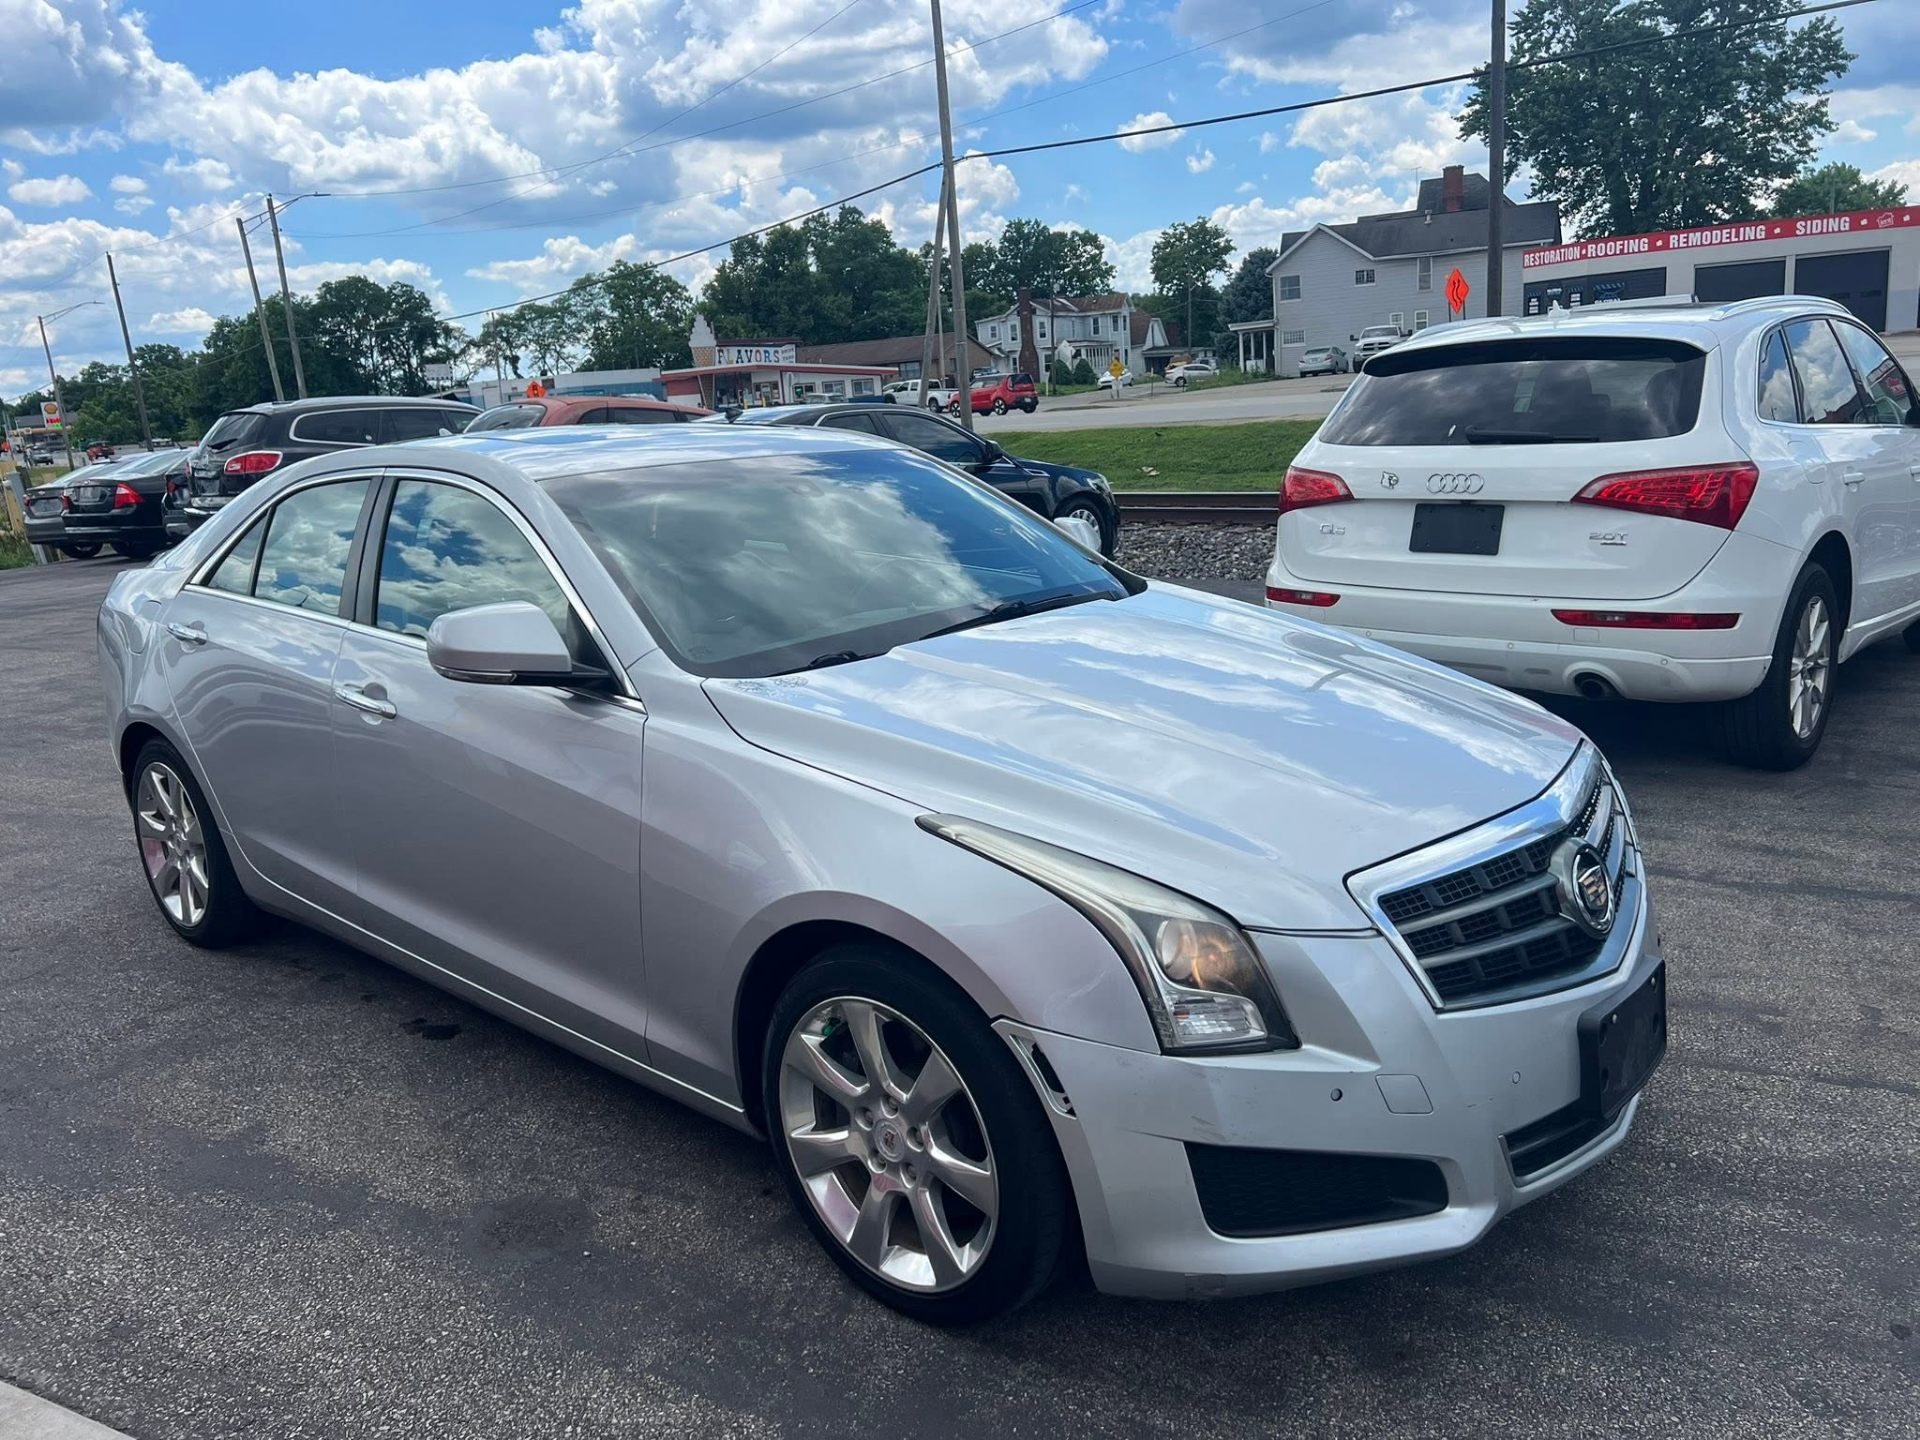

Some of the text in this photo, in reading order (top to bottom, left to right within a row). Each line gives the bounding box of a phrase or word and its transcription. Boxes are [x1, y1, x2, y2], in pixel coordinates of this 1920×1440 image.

[1524, 217, 1850, 267] RESTORATION ROOFING REMODELING SIDING
[717, 349, 780, 364] FLAVORS
